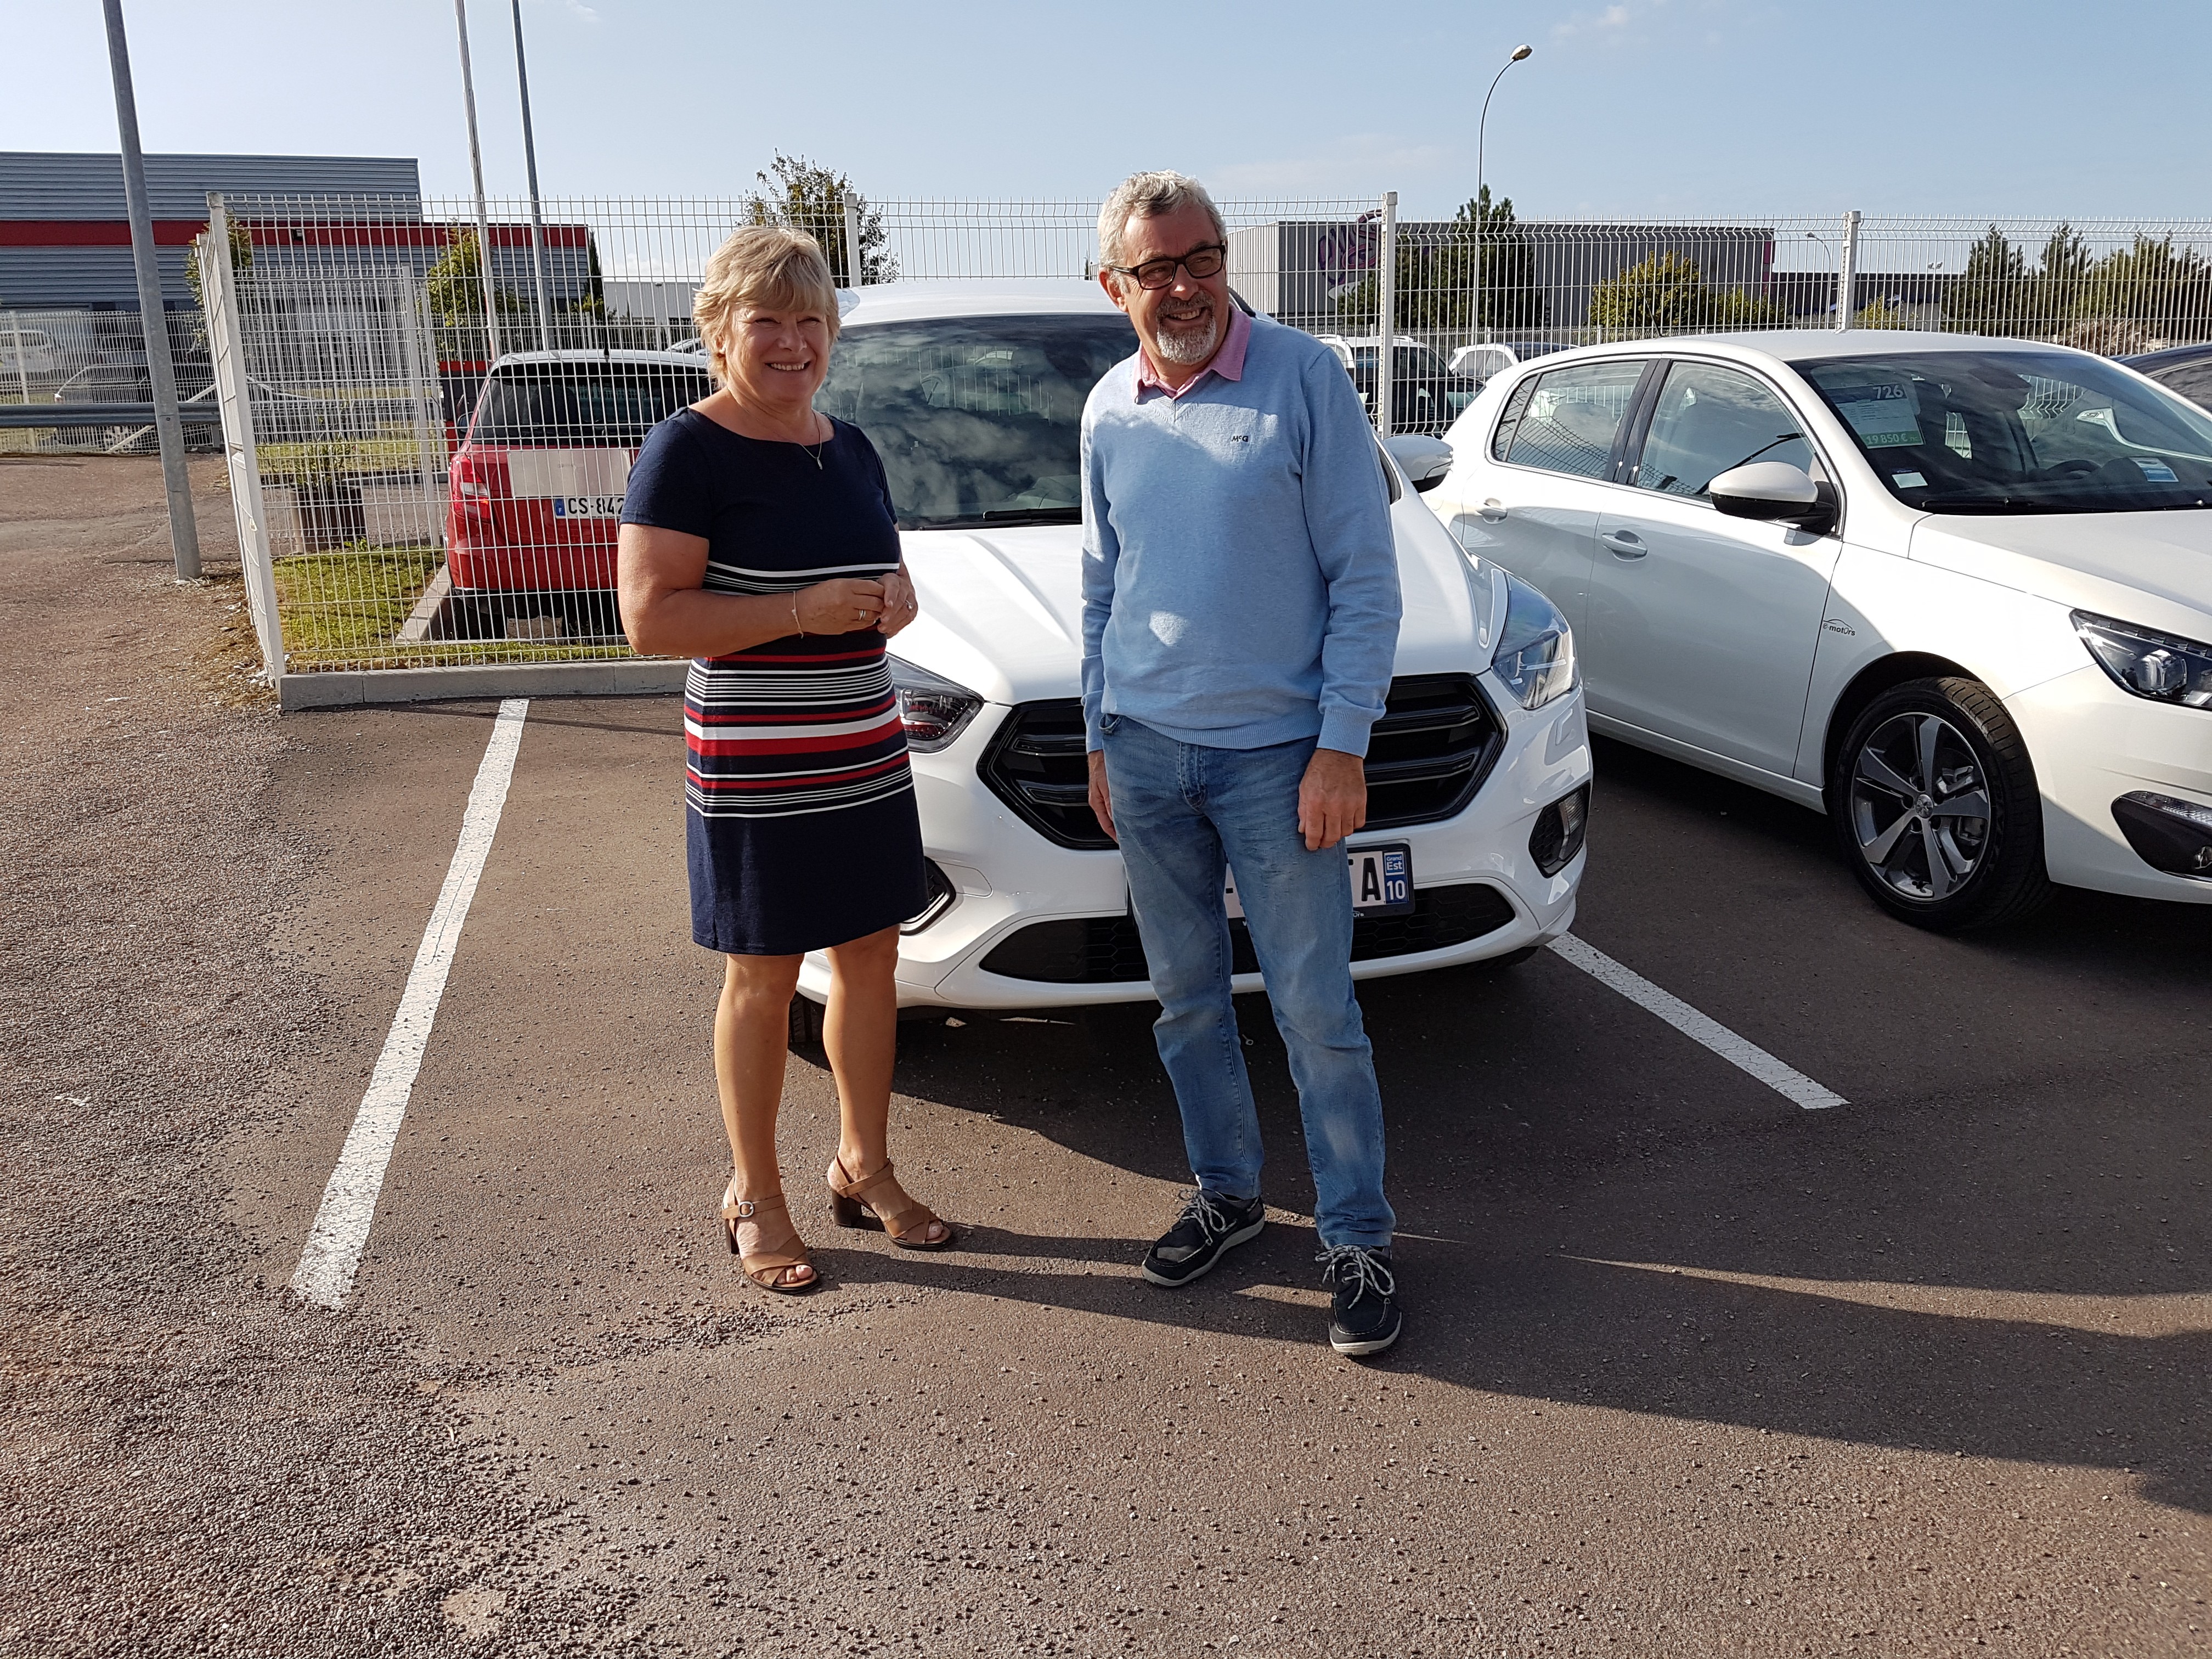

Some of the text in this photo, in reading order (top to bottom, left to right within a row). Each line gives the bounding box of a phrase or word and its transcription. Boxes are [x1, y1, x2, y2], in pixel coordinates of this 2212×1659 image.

[1872, 384, 1904, 399] 726
[1866, 435, 1878, 444] 19
[1880, 433, 1899, 443] 850
[1901, 433, 1908, 442] €
[1386, 861, 1403, 871] Est
[1386, 879, 1406, 900] 10
